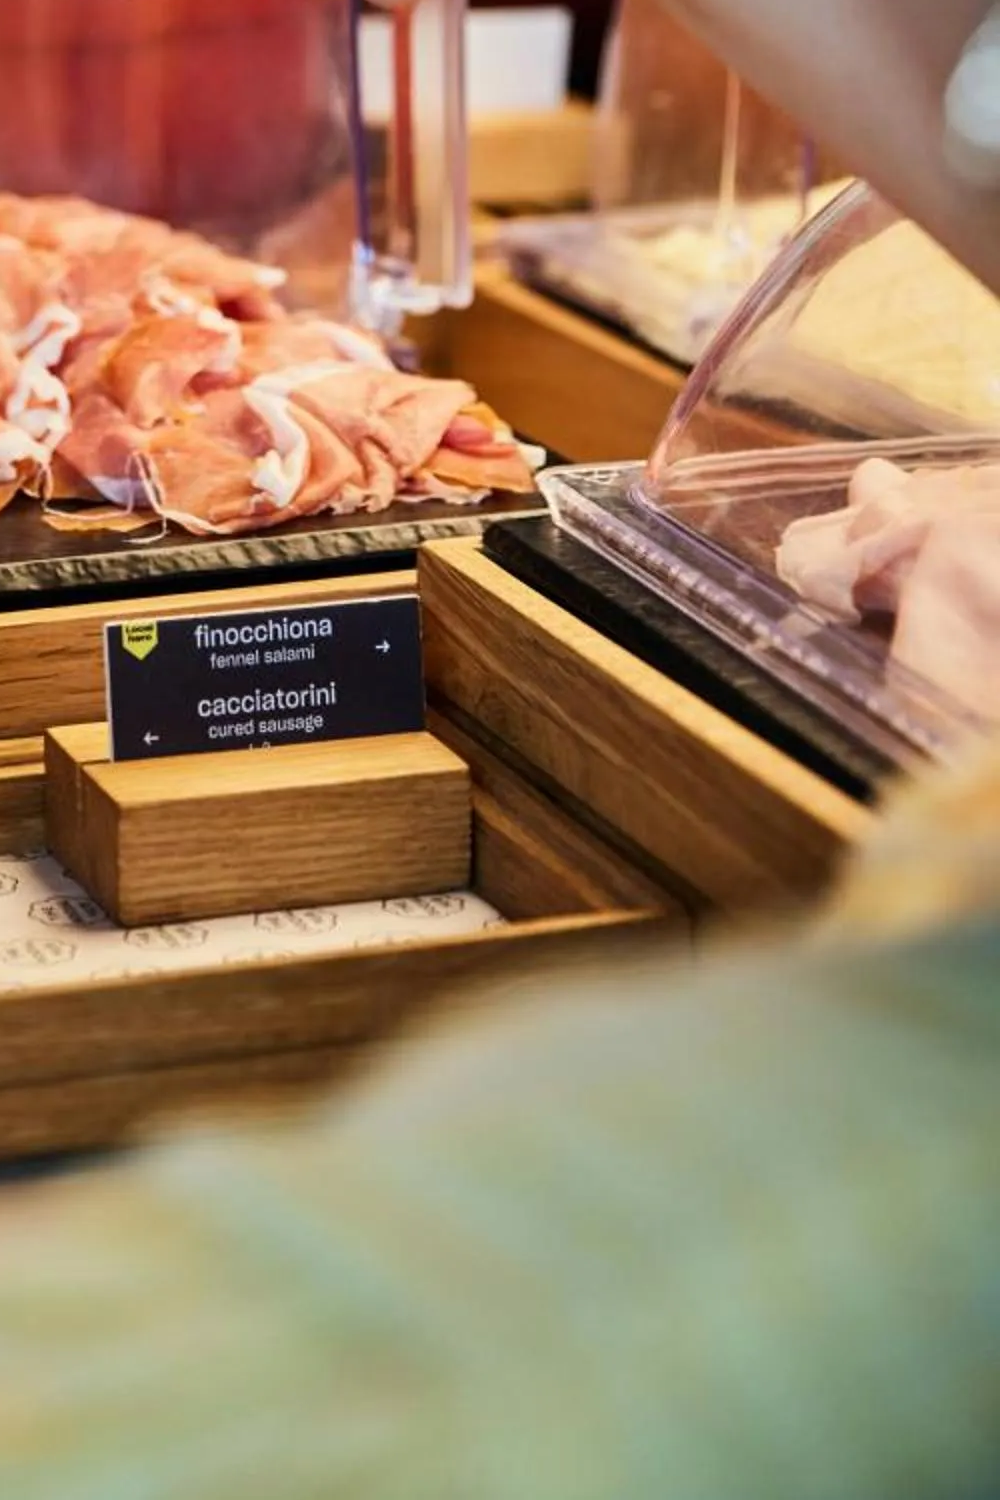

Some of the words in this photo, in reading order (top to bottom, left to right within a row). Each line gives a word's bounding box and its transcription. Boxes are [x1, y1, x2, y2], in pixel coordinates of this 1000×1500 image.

[195, 617, 332, 649] finocchiona
[210, 649, 259, 669] fennel
[264, 643, 315, 663] salami
[198, 681, 336, 717] cacciatorini
[208, 719, 254, 739] cured
[259, 713, 324, 733] sausage
